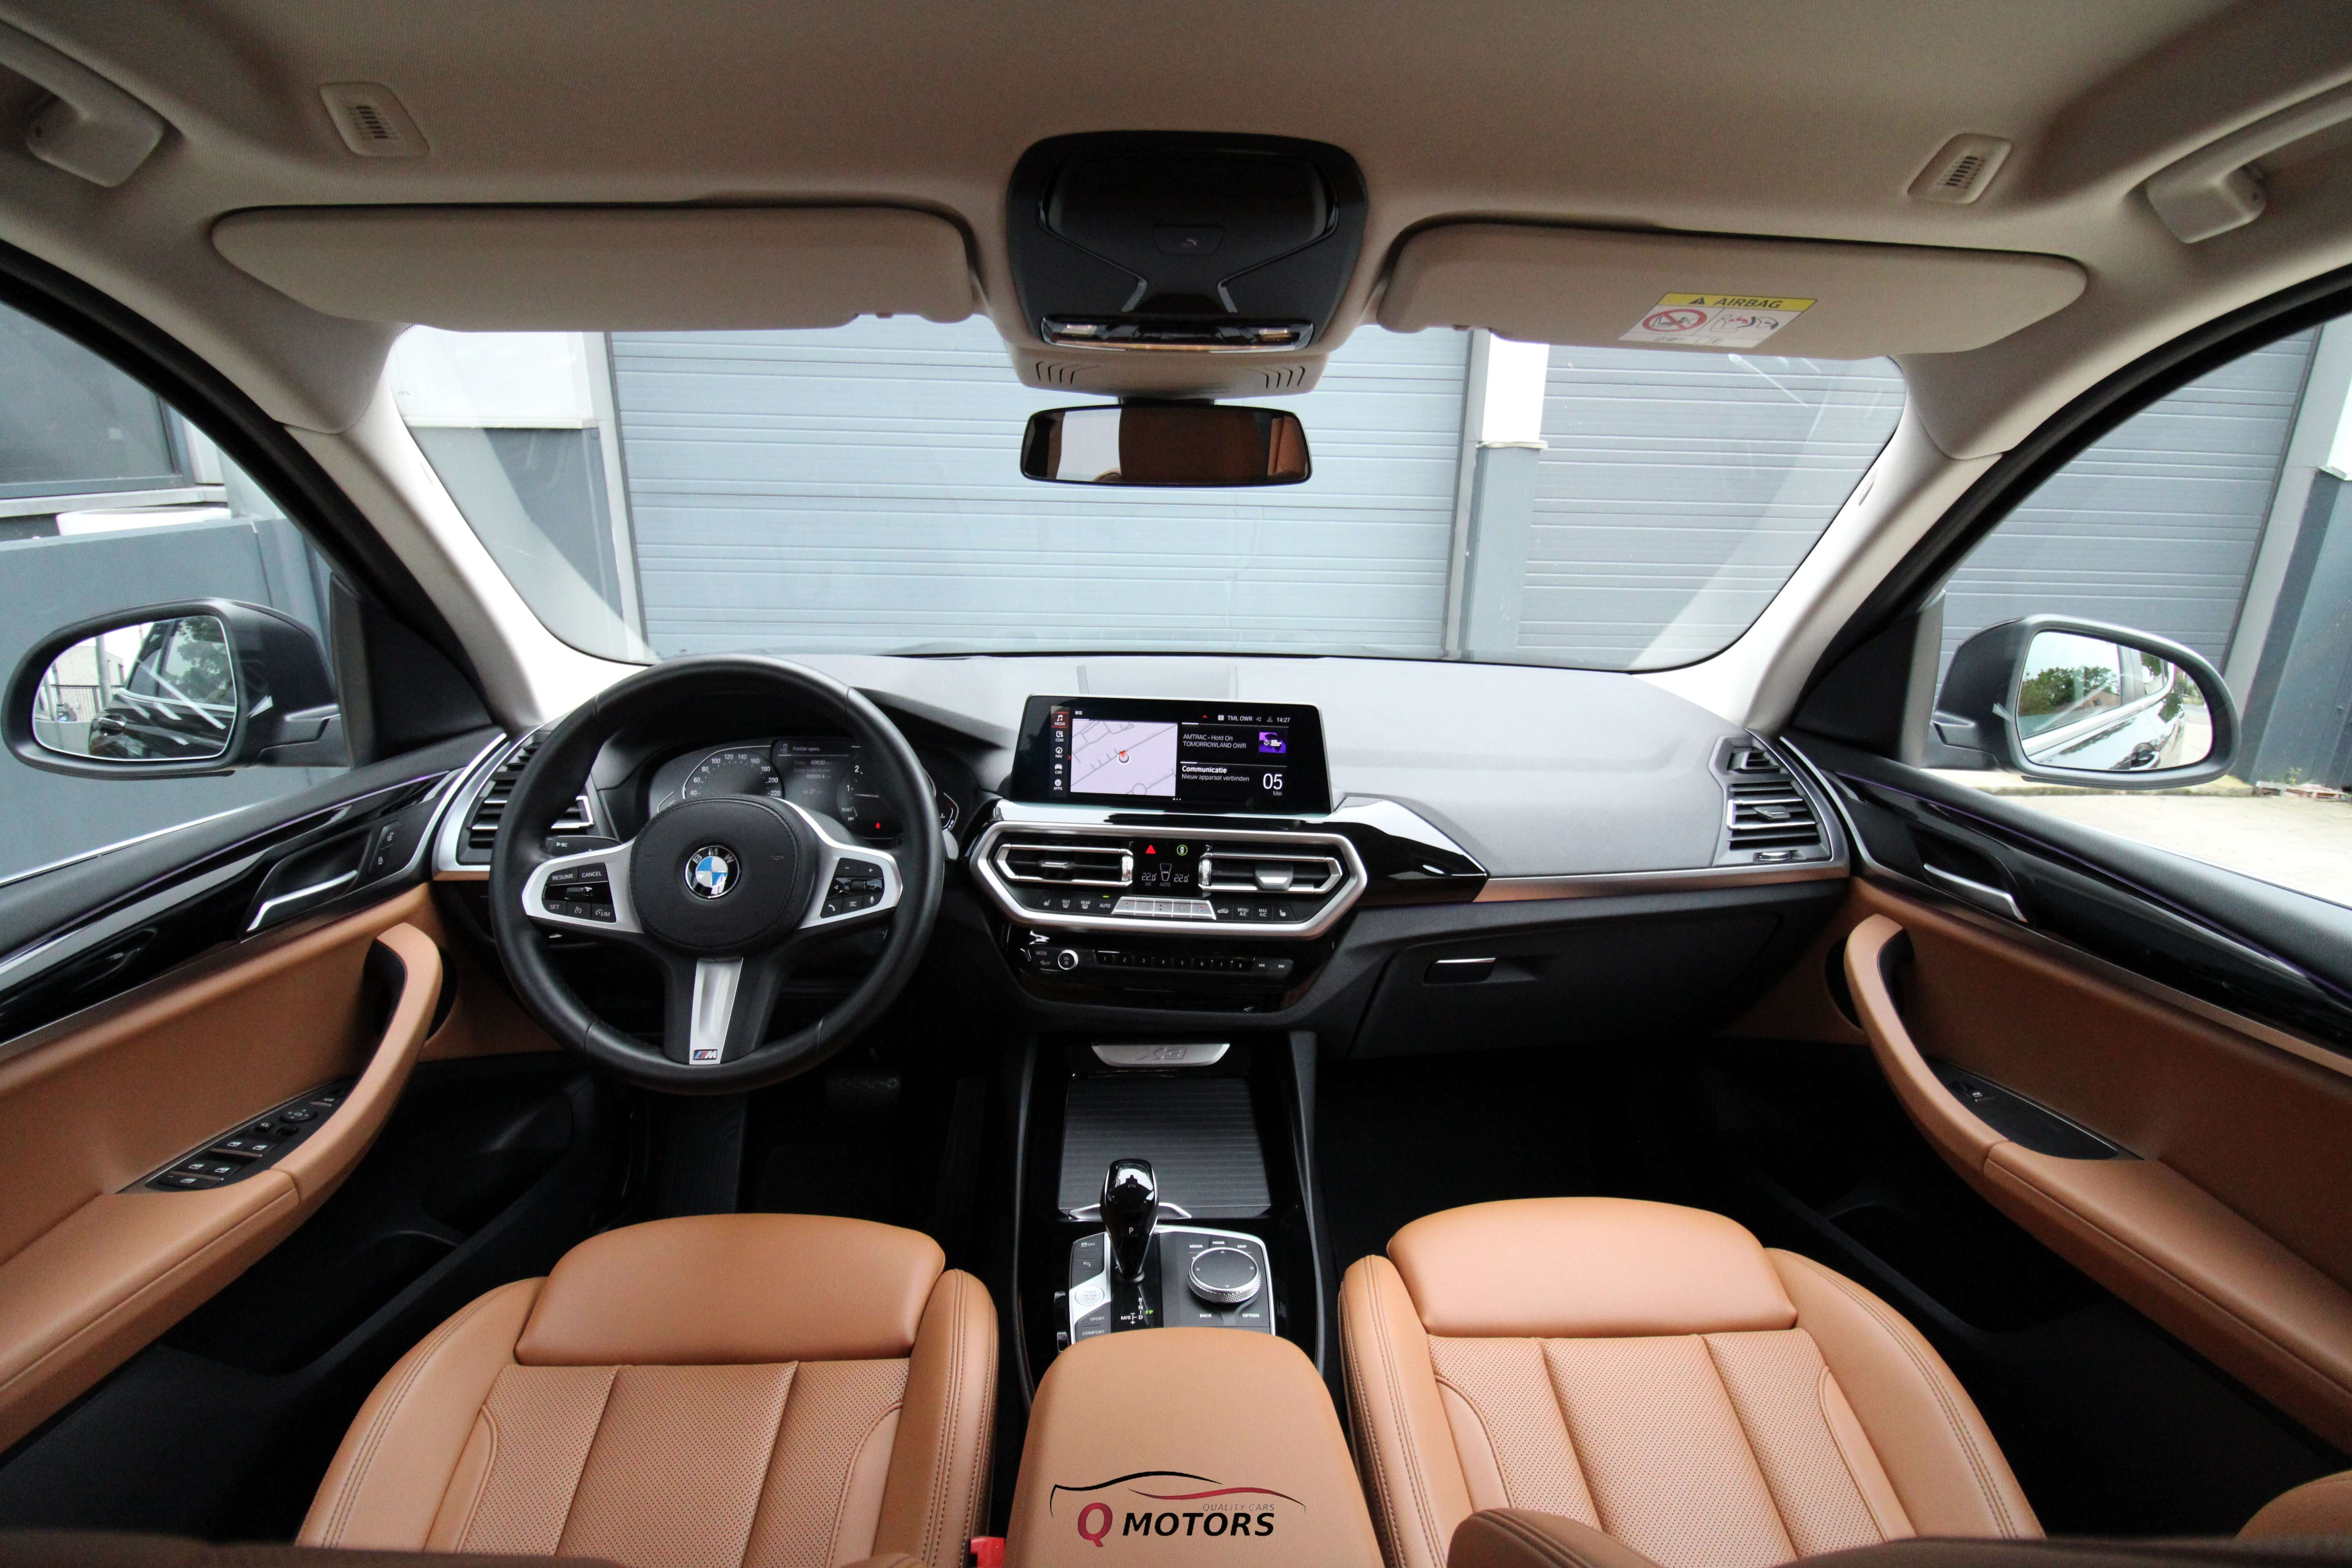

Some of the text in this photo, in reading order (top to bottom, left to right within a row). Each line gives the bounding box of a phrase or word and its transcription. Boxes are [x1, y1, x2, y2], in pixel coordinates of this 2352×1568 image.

[1714, 298, 1783, 309] AIRBAG
[1263, 773, 1283, 790] 05
[692, 848, 734, 864] BMW
